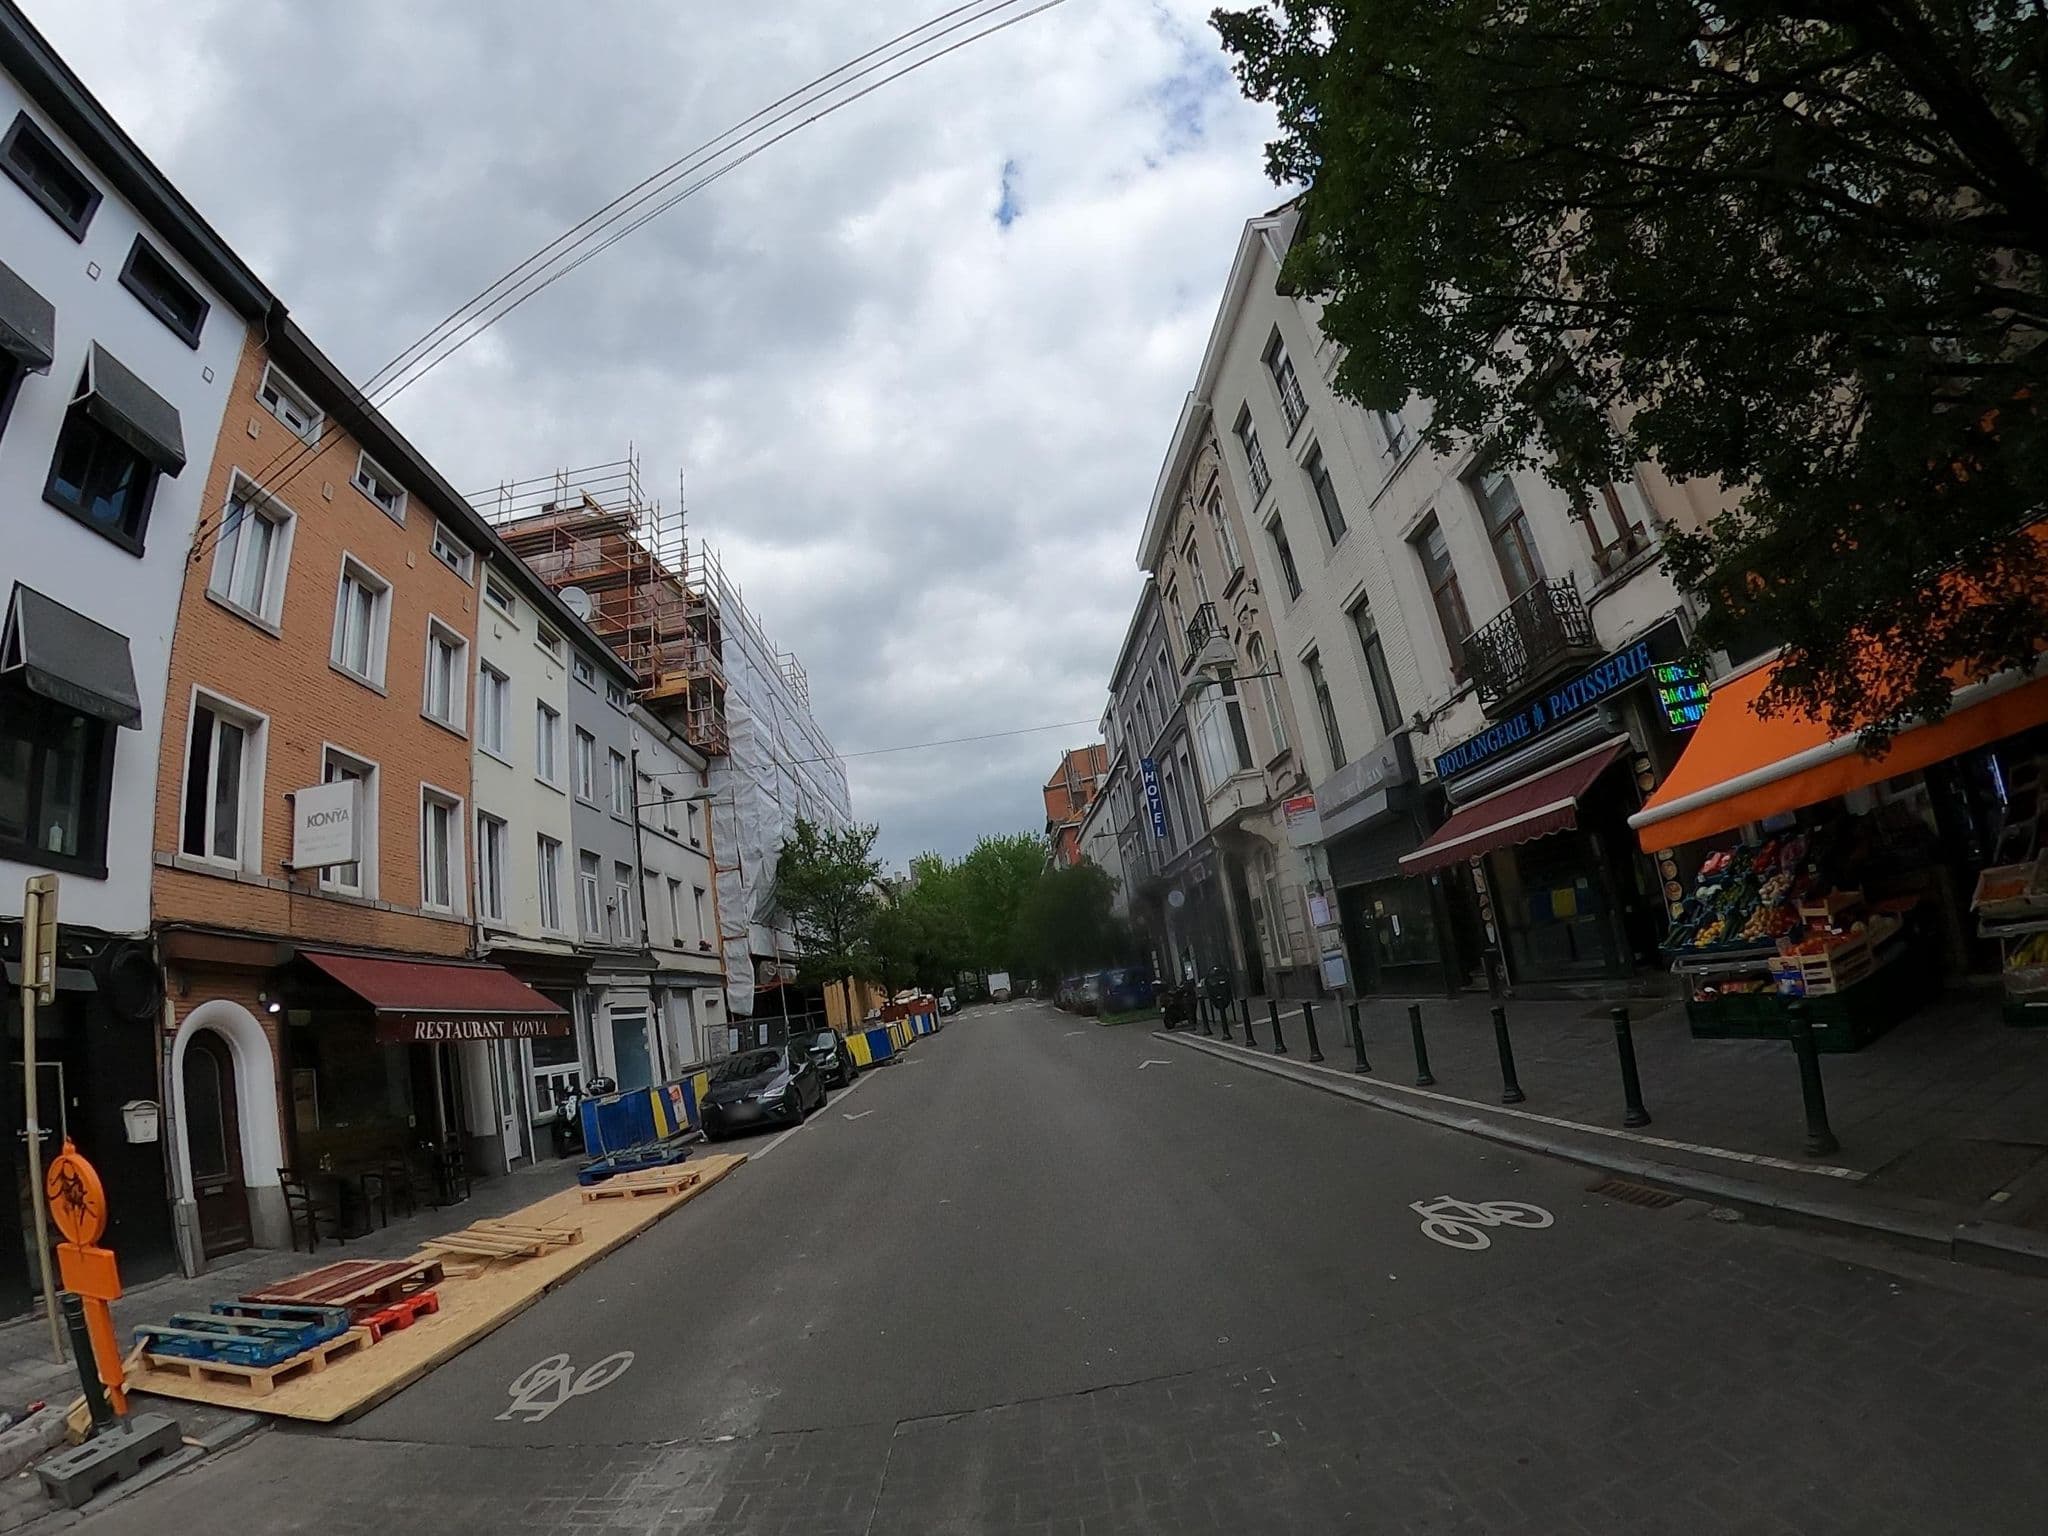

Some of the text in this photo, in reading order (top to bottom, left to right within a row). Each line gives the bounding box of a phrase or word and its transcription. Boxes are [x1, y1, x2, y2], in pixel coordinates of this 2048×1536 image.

[1438, 642, 1650, 777] BOULANGERIE PATISSERIE
[1145, 771, 1164, 837] HOTEL
[414, 1020, 548, 1040] RESTAURANT KONYA
